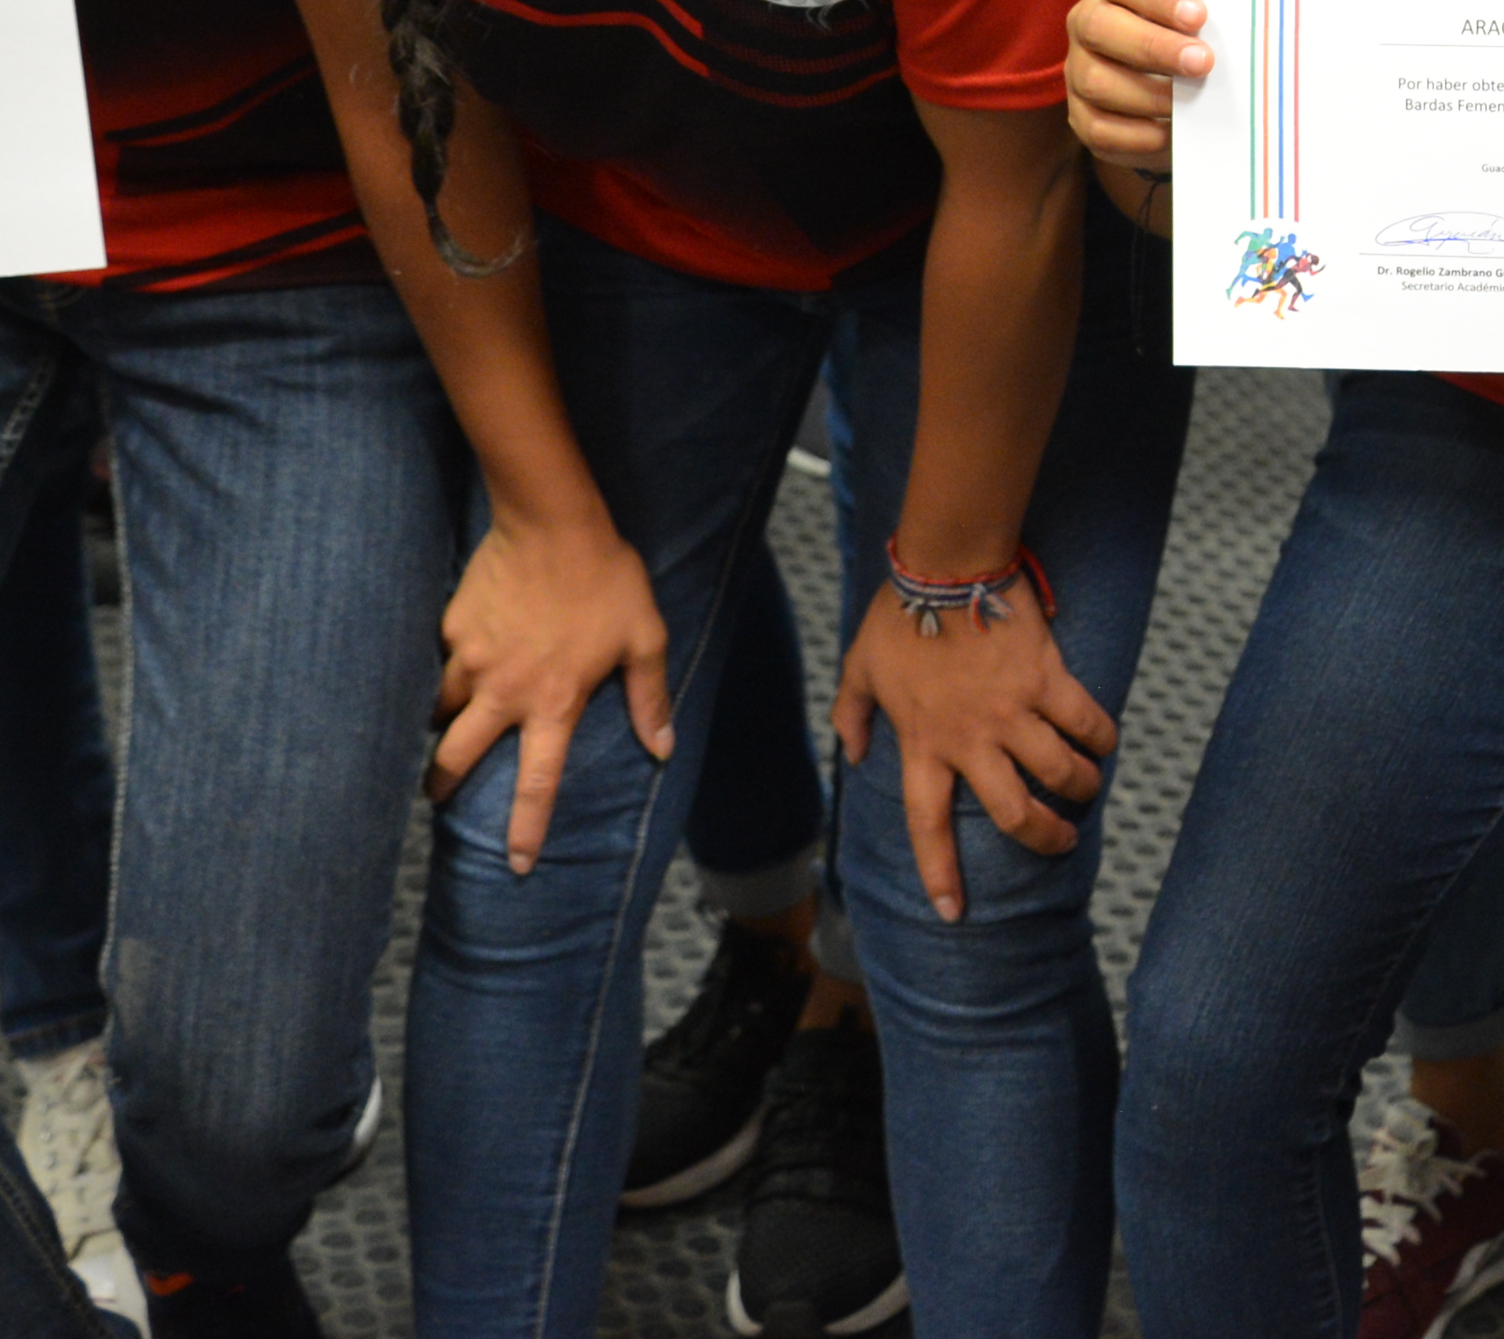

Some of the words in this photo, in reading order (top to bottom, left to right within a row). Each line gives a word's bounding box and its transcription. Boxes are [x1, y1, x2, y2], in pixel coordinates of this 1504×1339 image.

[1397, 77, 1422, 90] Por
[1426, 77, 1467, 91] haber
[1404, 97, 1453, 112] Bardas
[1376, 265, 1393, 275] Dr.
[1395, 265, 1436, 278] Rogelio
[1438, 266, 1493, 277] Zambrano
[1401, 280, 1454, 292] Secretario
